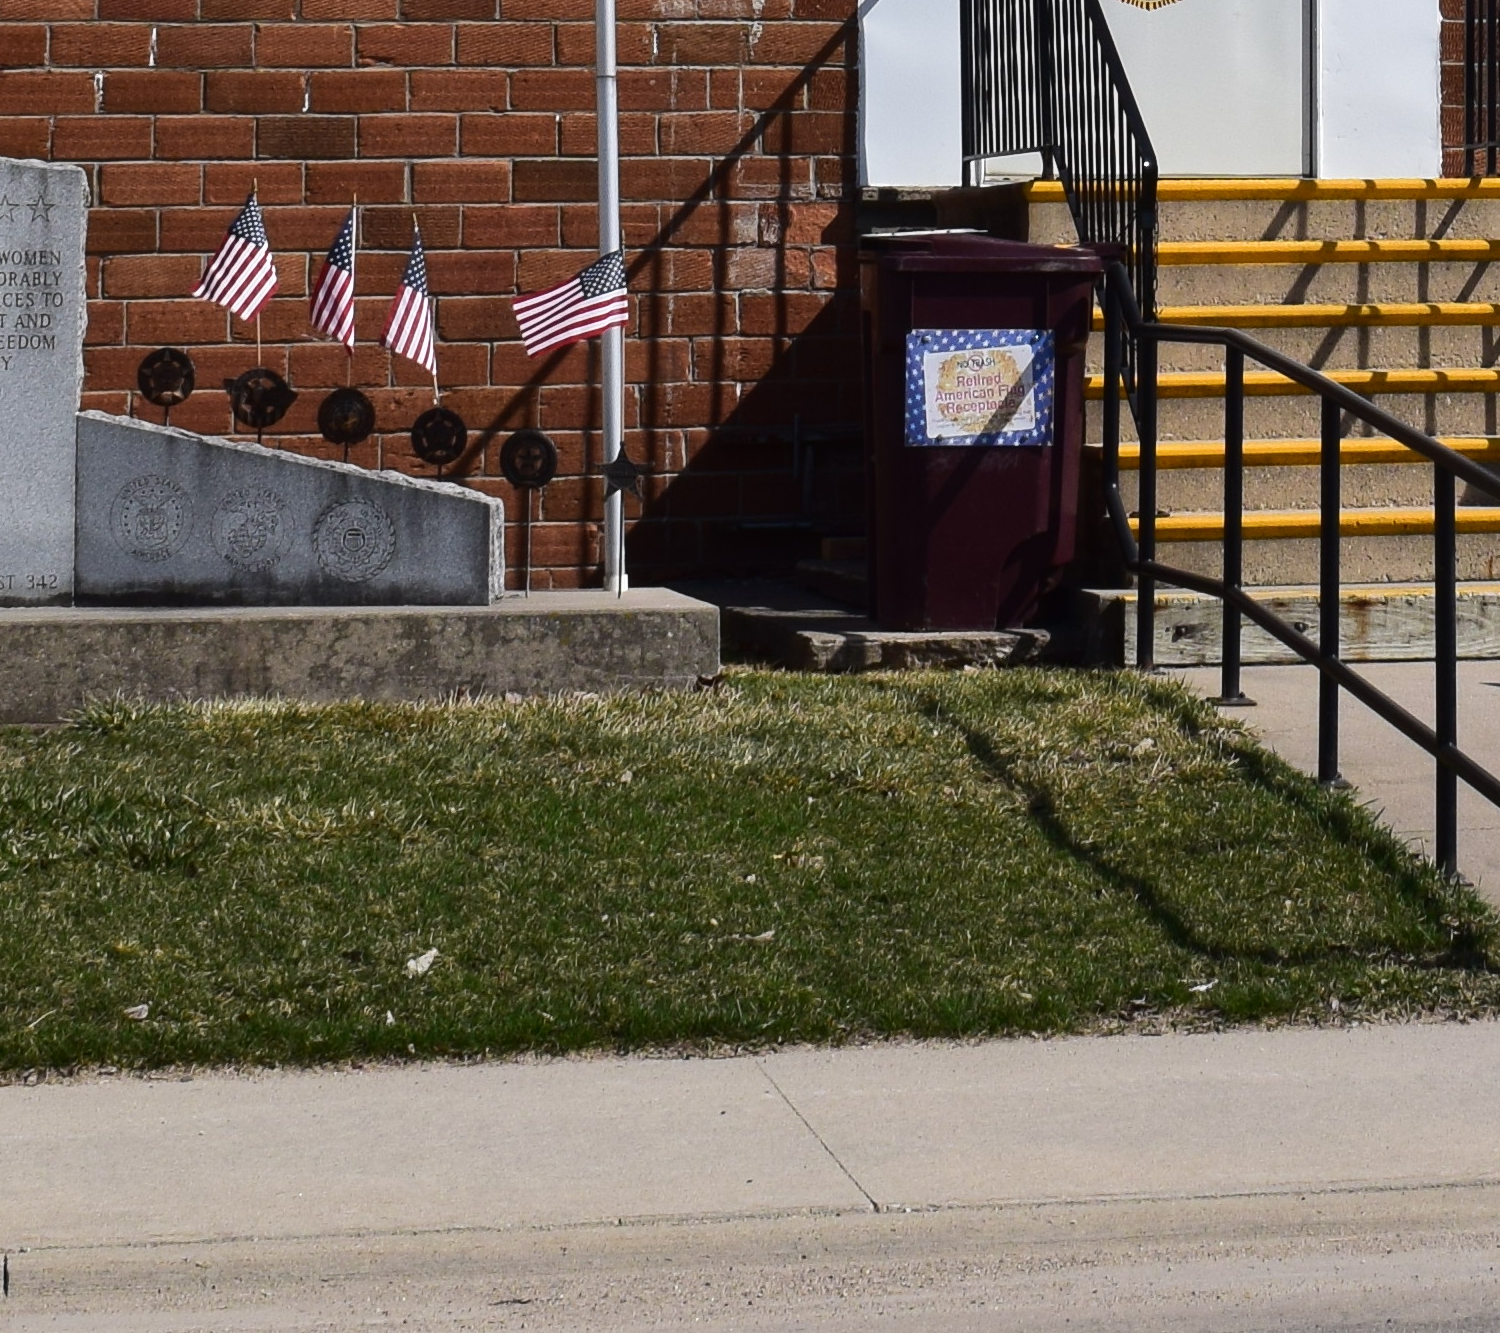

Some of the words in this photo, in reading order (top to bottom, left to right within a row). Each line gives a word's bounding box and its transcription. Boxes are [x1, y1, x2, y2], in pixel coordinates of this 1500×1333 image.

[41, 293, 64, 309] TO
[13, 314, 52, 330] AND
[956, 373, 1002, 387] Retired
[934, 388, 995, 403] American
[26, 573, 59, 590] 342
